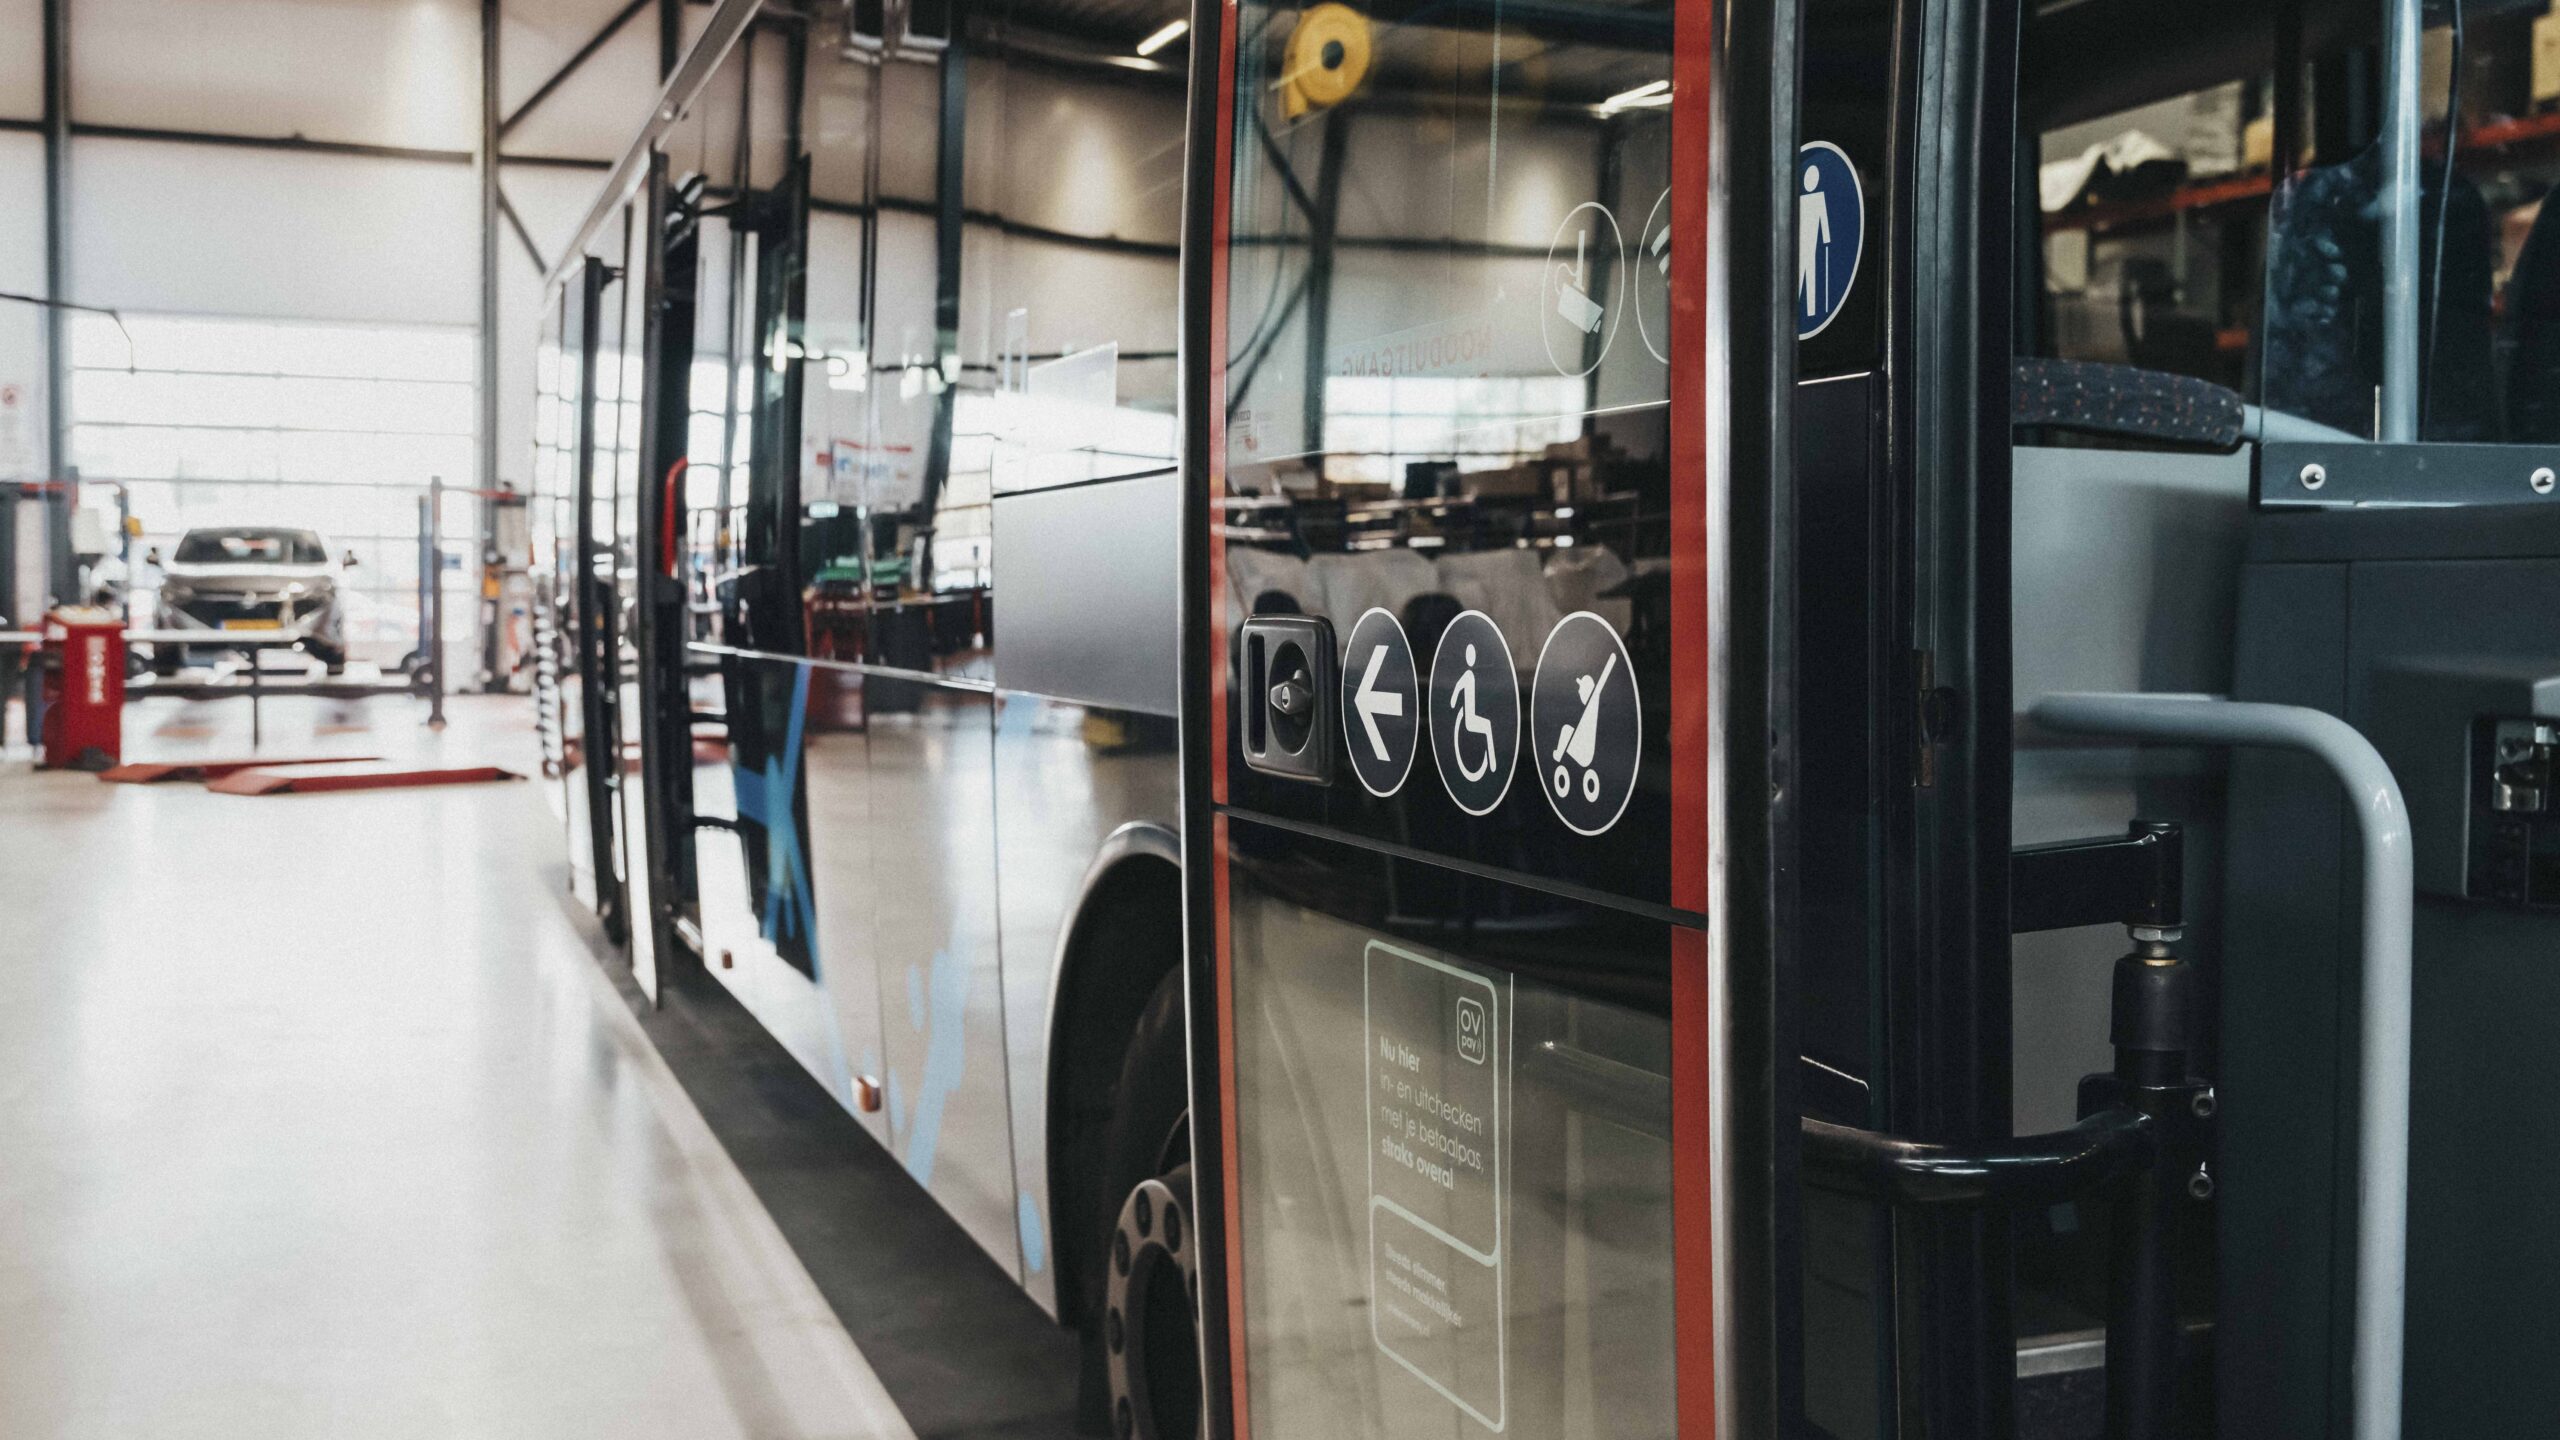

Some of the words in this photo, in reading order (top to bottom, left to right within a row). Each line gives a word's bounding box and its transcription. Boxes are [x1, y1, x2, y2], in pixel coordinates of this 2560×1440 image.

[1460, 1009, 1481, 1035] OV
[1461, 1035, 1477, 1053] pay
[1380, 1036, 1396, 1062] Nu
[1399, 1042, 1420, 1073] hier
[1380, 1068, 1394, 1092] in-
[1397, 1081, 1412, 1104] en
[1415, 1085, 1482, 1136] uitchecken
[1381, 1104, 1402, 1130] met
[1405, 1111, 1416, 1139] je
[1419, 1119, 1484, 1174] betaalpas,
[1382, 1134, 1414, 1169] straks
[1417, 1156, 1453, 1190] overal
